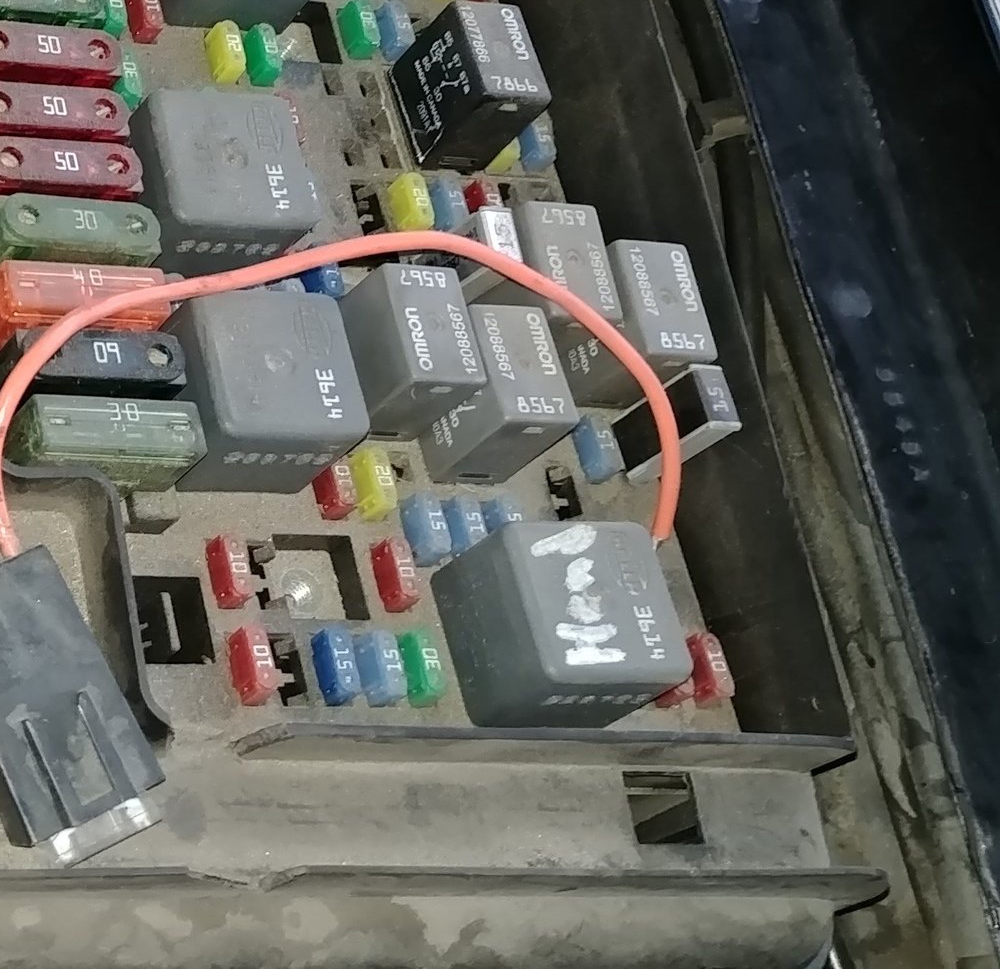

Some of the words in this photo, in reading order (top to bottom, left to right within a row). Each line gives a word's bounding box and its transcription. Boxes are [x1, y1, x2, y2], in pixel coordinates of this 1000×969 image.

[37, 34, 62, 54] 50
[225, 34, 241, 52] 20
[262, 36, 279, 54] 30
[460, 4, 490, 65] 12077866
[122, 61, 138, 82] 30
[414, 59, 427, 87] MADE
[426, 94, 442, 130] CANADA
[490, 75, 539, 93] 7866
[42, 96, 67, 116] 50
[54, 151, 79, 171] 50
[265, 163, 290, 210] 3614
[412, 188, 429, 207] 20
[73, 210, 98, 230] 30
[541, 208, 587, 226] 8567
[400, 269, 447, 288] 8567
[587, 242, 616, 311] 12088567
[629, 247, 659, 316] 12088567
[447, 303, 478, 374] 12088567
[483, 312, 515, 381] 12088567
[660, 332, 706, 350] 8567
[315, 368, 343, 419] 3614
[707, 386, 730, 413] 15
[517, 396, 565, 415] 8567
[597, 430, 615, 450] 15
[334, 465, 354, 486] 10
[375, 465, 394, 487] 20
[428, 510, 447, 530] 15
[466, 512, 485, 533] 15
[507, 512, 523, 522] 5
[230, 552, 248, 574] 10
[396, 556, 415, 578] 10
[633, 605, 666, 660] 3614
[253, 644, 273, 668] 10
[334, 648, 354, 671] 15
[383, 649, 402, 672] 15
[422, 647, 441, 671] 30
[707, 647, 728, 673] 10
